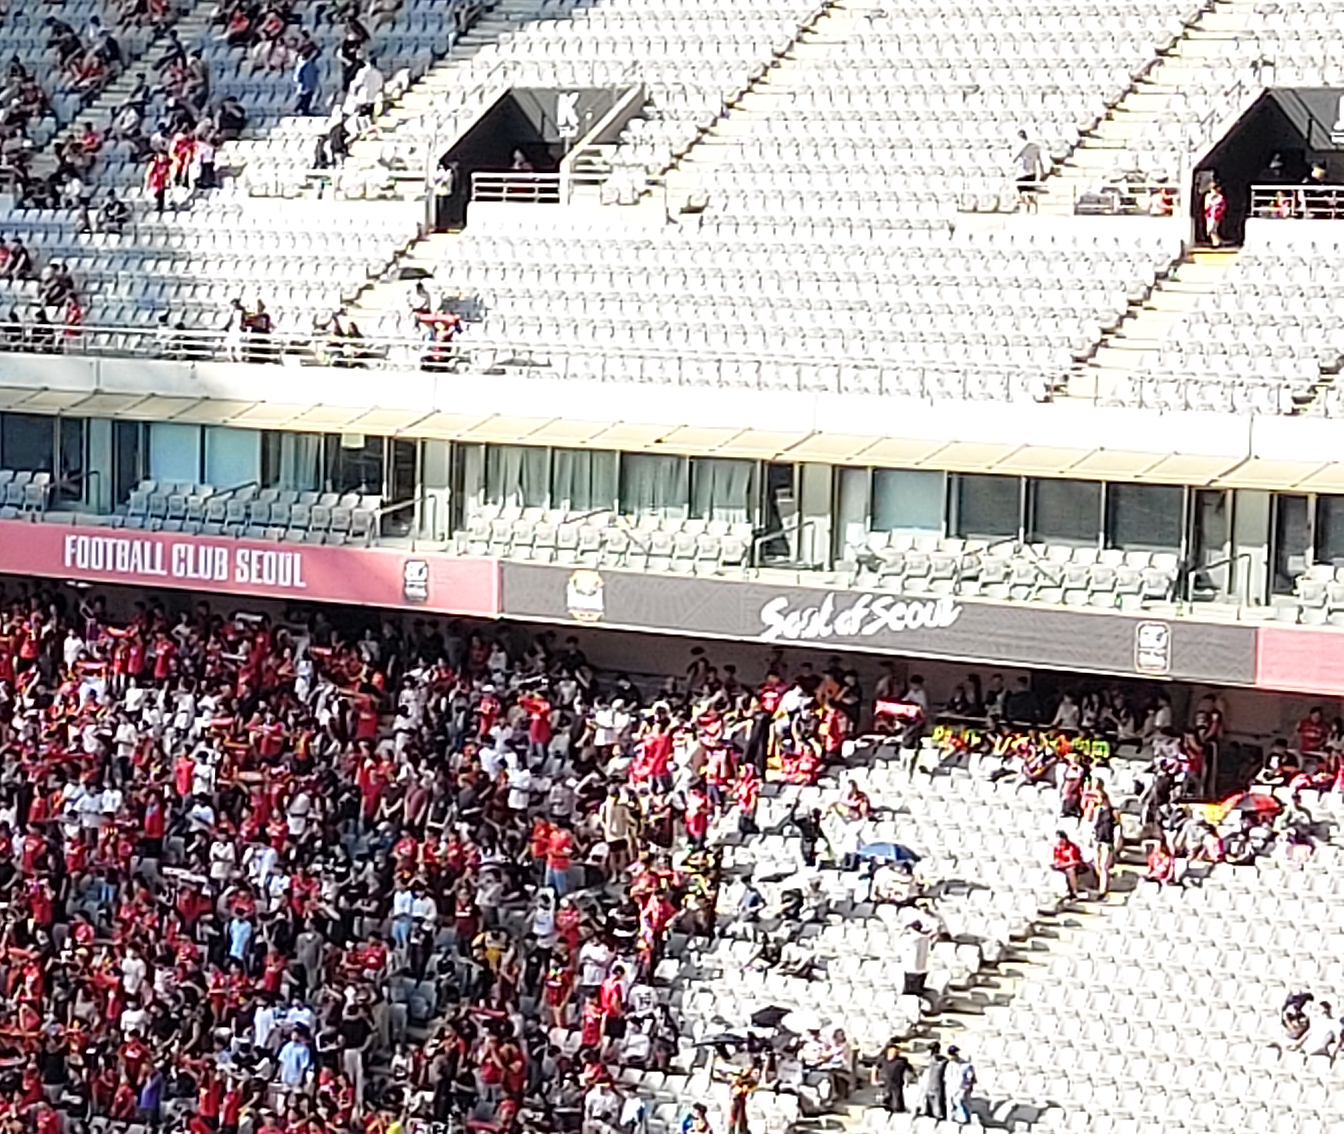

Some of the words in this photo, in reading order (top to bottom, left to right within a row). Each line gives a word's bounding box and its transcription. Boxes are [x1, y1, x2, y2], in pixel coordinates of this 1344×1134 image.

[64, 534, 168, 577] FOOTBALL
[171, 542, 229, 582] CLUB
[234, 549, 307, 589] SEOUL
